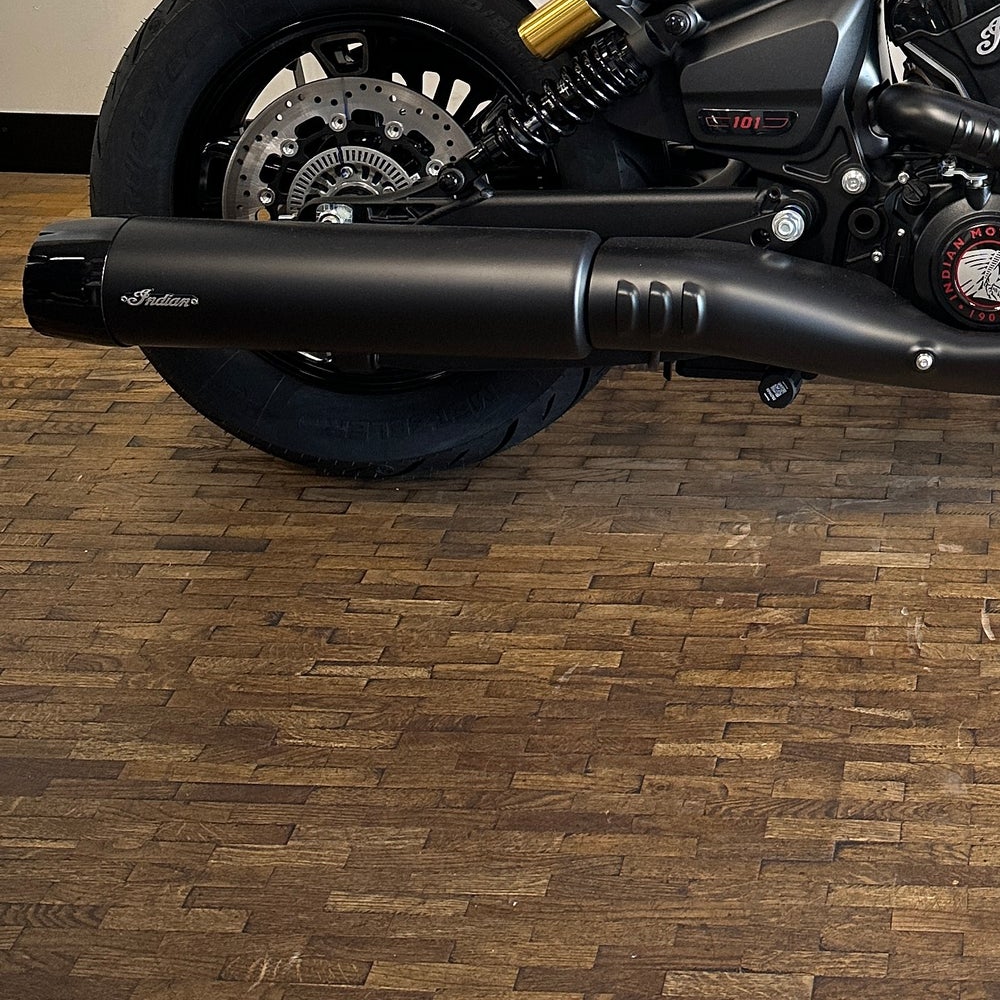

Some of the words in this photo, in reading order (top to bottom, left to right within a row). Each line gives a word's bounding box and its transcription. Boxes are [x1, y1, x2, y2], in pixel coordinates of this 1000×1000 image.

[732, 116, 762, 130] 101
[941, 236, 966, 300] INDIAN
[126, 287, 191, 308] Indian
